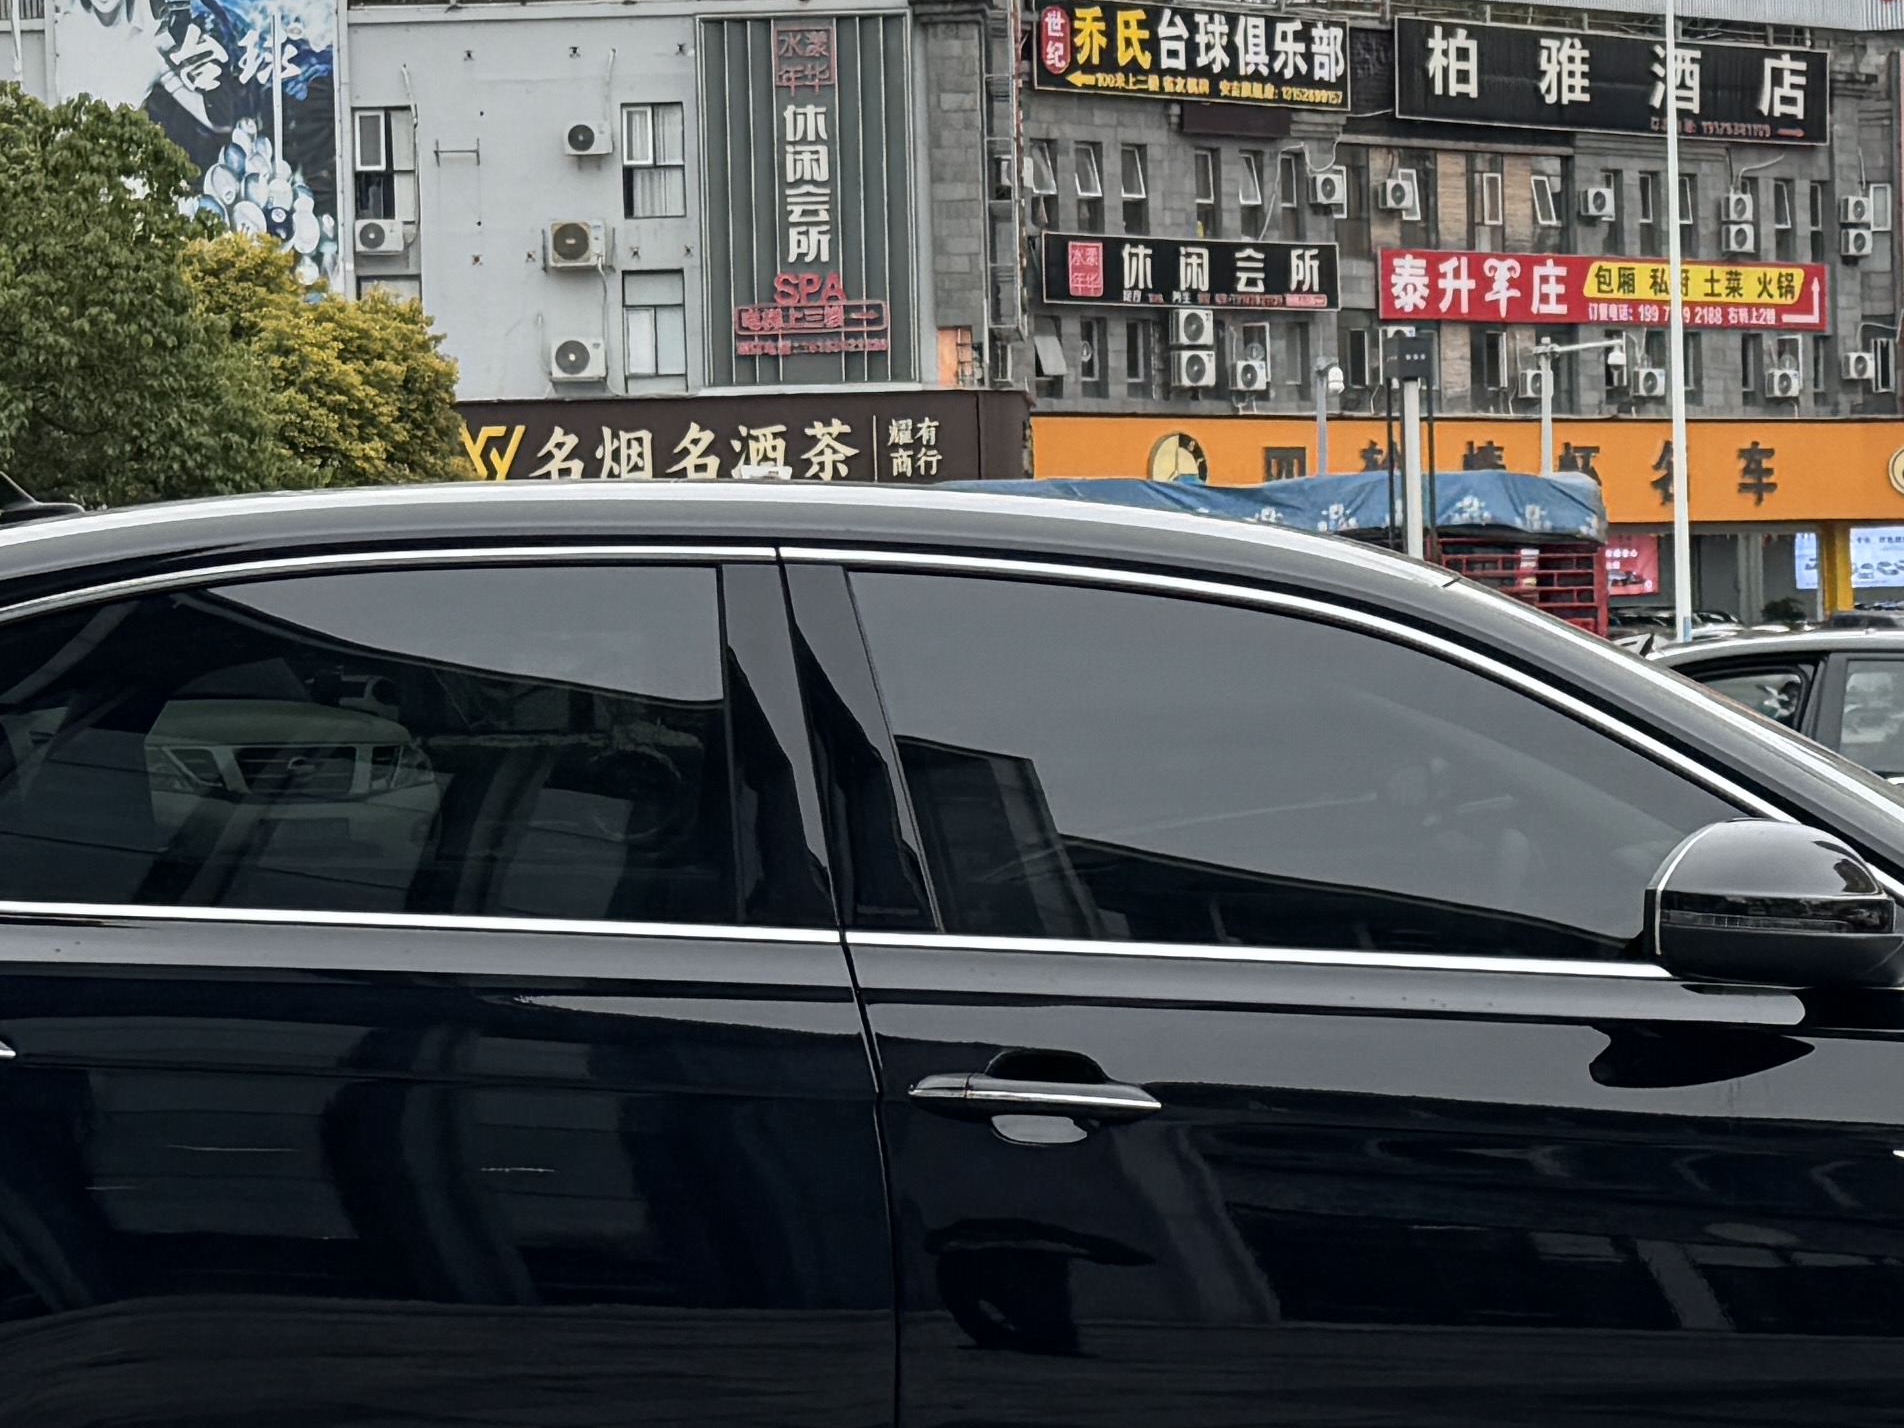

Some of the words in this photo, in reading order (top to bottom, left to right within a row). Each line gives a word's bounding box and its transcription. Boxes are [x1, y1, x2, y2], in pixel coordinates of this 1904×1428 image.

[171, 23, 302, 92] 台球
[1045, 10, 1066, 68] 世纪
[1073, 5, 1346, 83] 乔氏台球俱乐部
[1427, 25, 1808, 120] 柏雅酒店
[783, 104, 832, 263] 休闲会所
[773, 271, 848, 304] SPA
[1122, 243, 1320, 293] 休闲会所
[1391, 253, 1568, 318] 泰升羊庄
[1595, 265, 1636, 296] 包厢
[1704, 269, 1744, 299] 土菜
[1757, 271, 1796, 301] 火锅
[1664, 306, 1691, 324] 79
[534, 418, 860, 481] 名烟名酒茶
[889, 447, 943, 477] 商行
